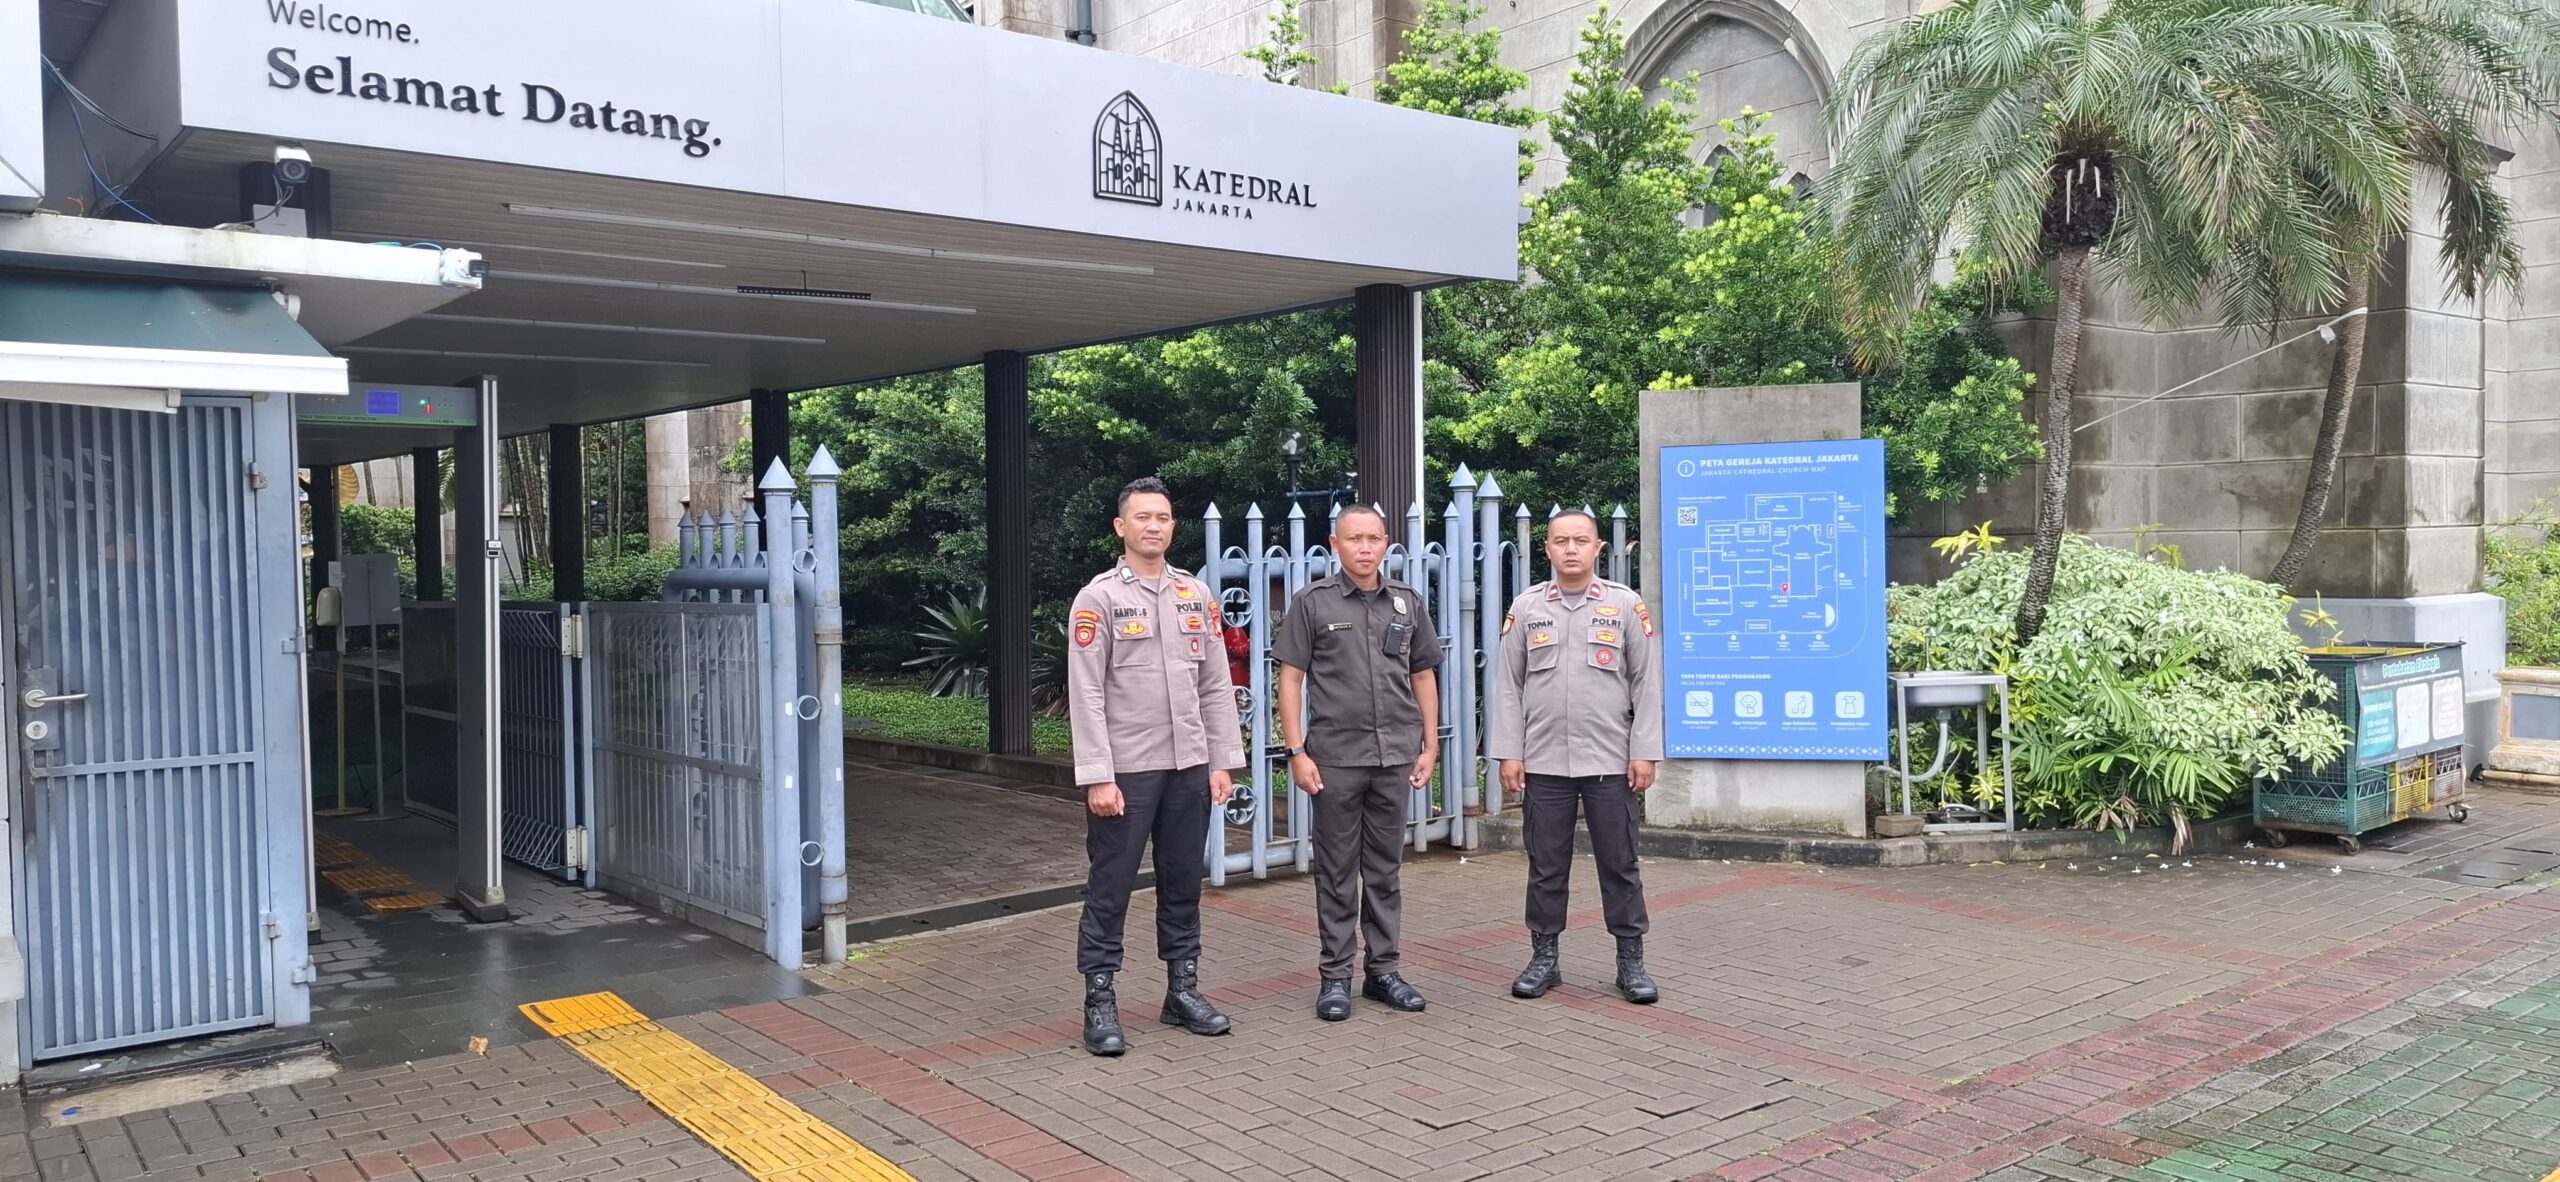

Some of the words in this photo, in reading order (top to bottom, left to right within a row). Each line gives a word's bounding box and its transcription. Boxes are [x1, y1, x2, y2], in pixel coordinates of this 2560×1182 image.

[268, 0, 419, 44] Welcome.
[267, 46, 505, 117] Selamat
[521, 82, 723, 158] Datang.
[1172, 164, 1318, 208] KATEDRAL
[1172, 197, 1253, 220] JAKARTA
[1700, 459, 1724, 467] PETA
[1726, 457, 1762, 466] GEREJA
[1764, 455, 1814, 465] KATEDRAL
[1815, 453, 1860, 463] JAKARTA
[1700, 469, 1732, 477] JAKARTA
[1733, 467, 1776, 475] CATHEDRAL
[1777, 465, 1809, 474] CHURCH
[1175, 601, 1203, 613] POLRI
[1527, 619, 1554, 631] TOPAN
[1591, 617, 1622, 628] POLRI
